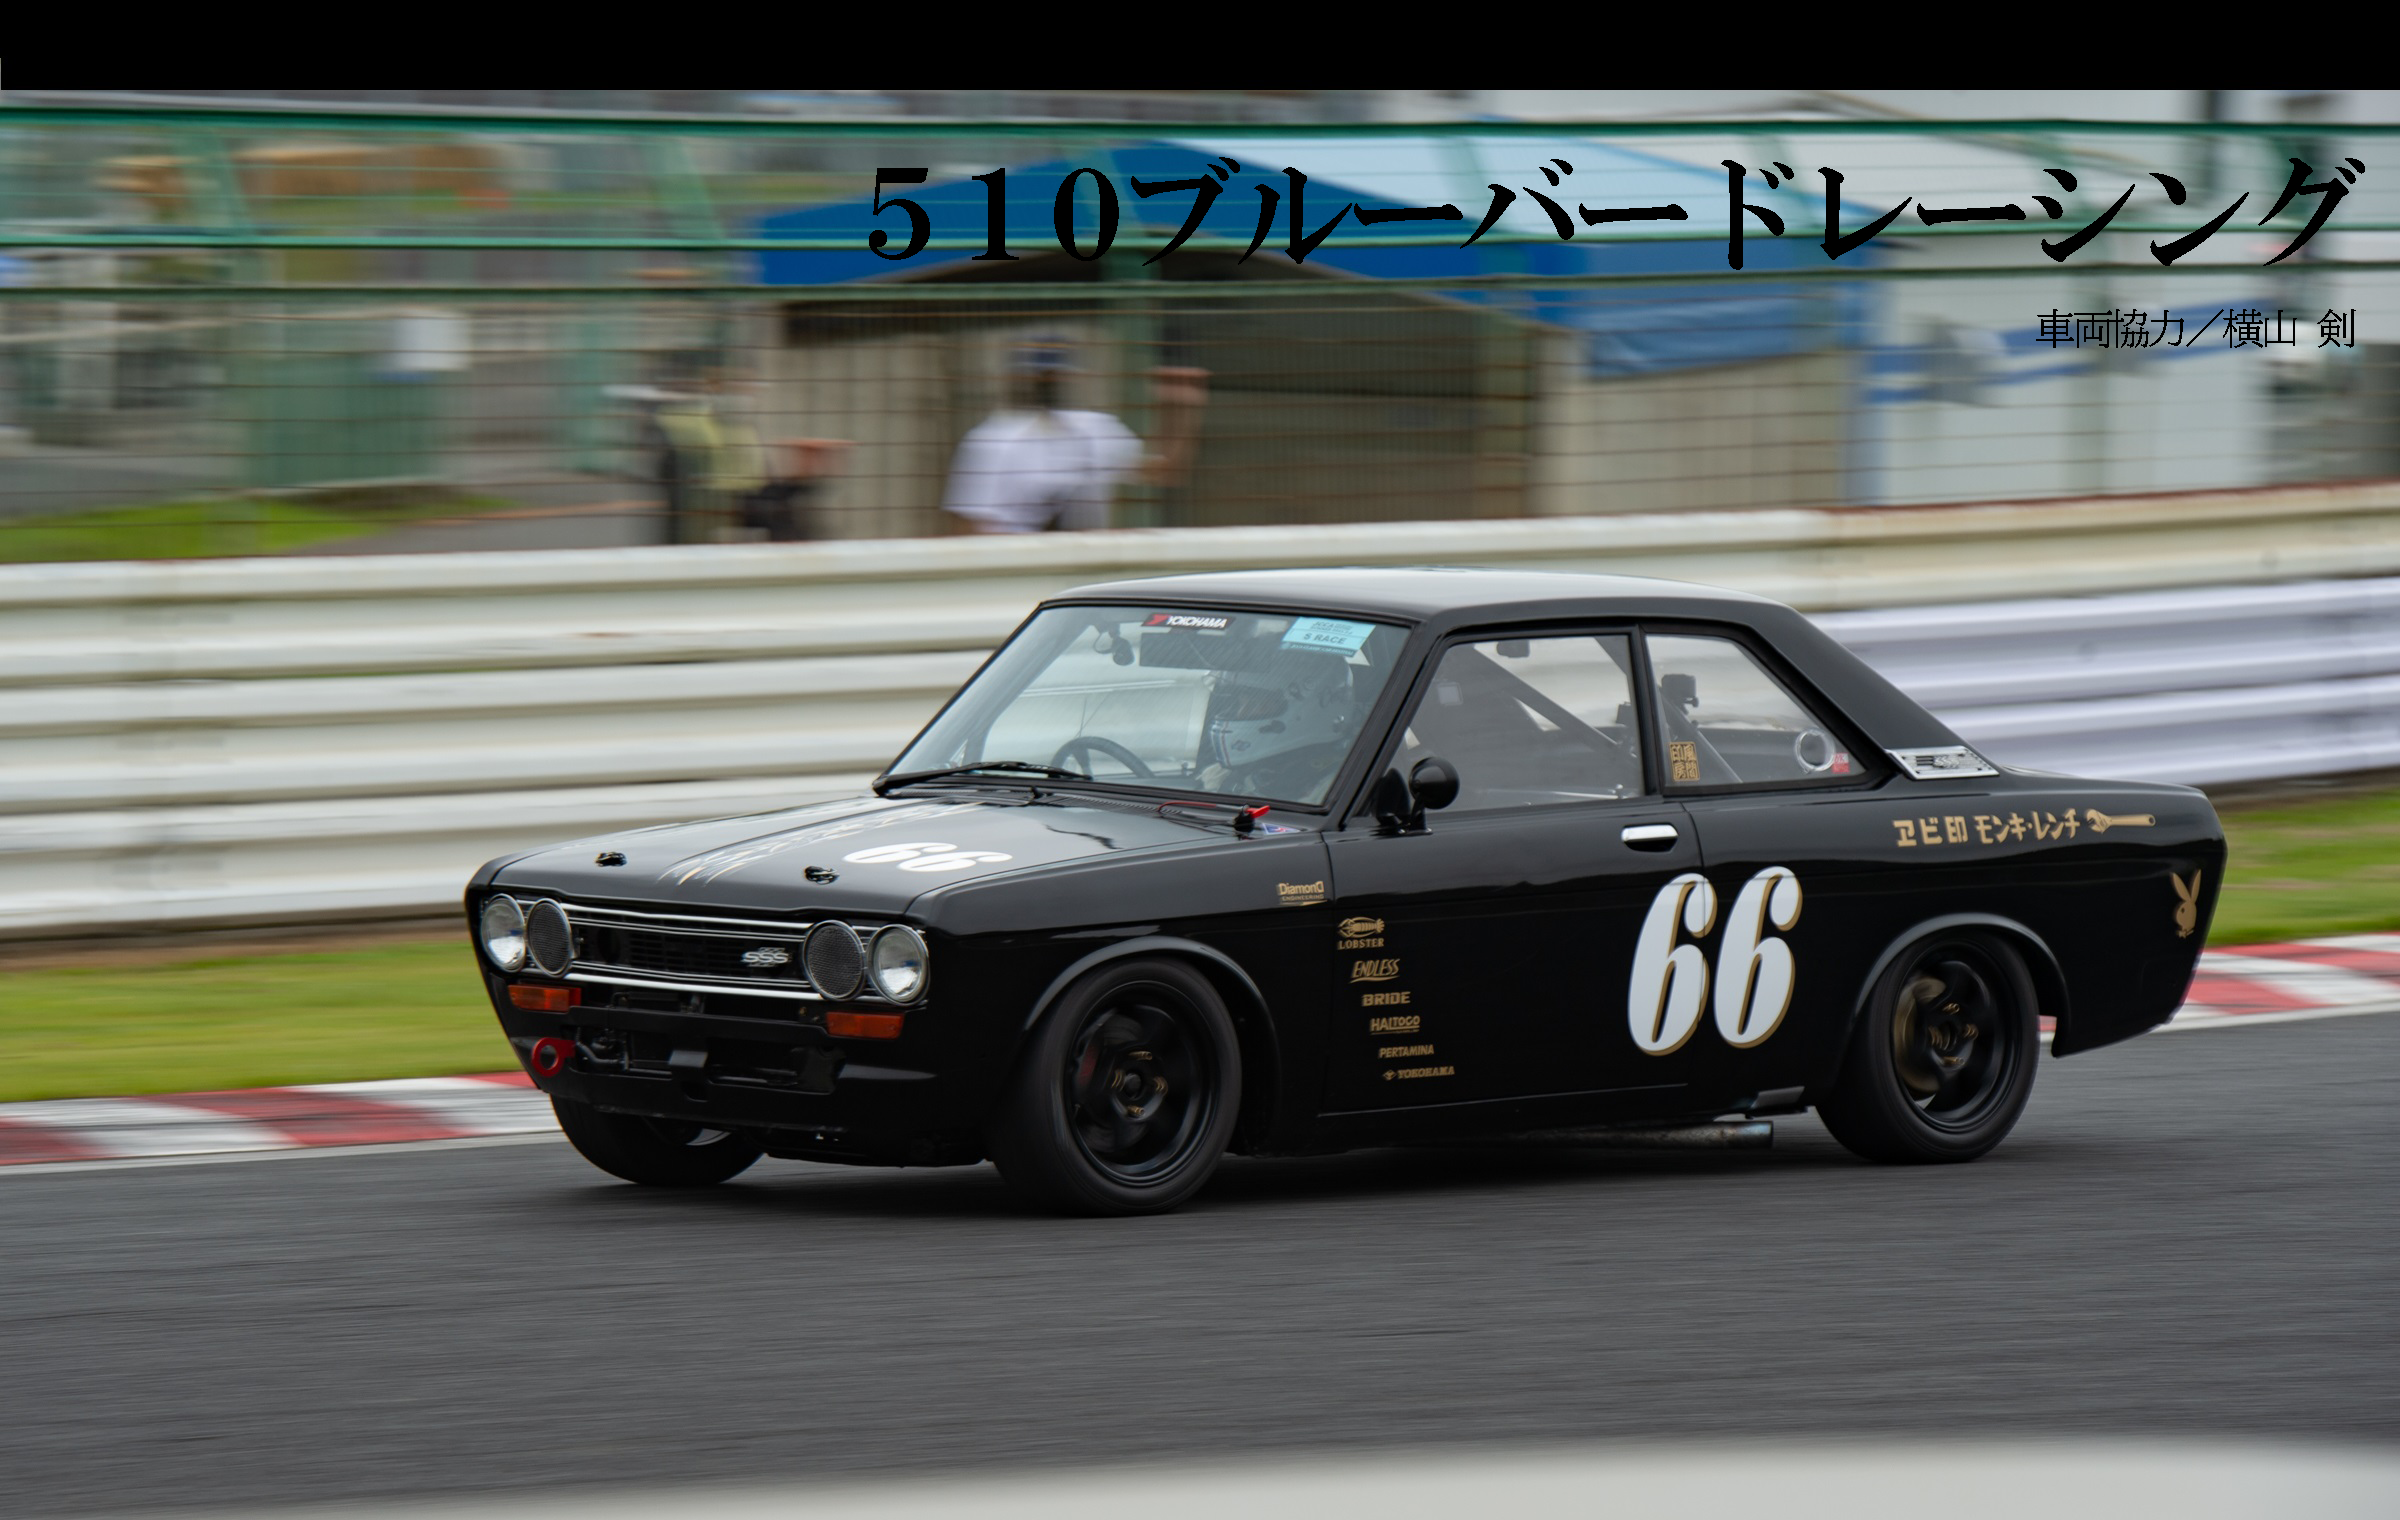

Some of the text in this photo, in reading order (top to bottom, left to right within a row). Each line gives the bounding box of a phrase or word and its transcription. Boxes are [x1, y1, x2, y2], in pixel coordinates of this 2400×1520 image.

[1166, 615, 1228, 628] YOKOHAMA
[1304, 632, 1347, 645] S RACE
[843, 842, 1013, 873] 66
[1338, 937, 1385, 950] LOBSTER
[742, 951, 789, 964] SSS
[1627, 865, 1804, 1057] 66
[1352, 958, 1401, 979] ENDLESS
[1362, 991, 1411, 1007] BRIDE
[1379, 1044, 1435, 1058] PERTAMINA
[1397, 1066, 1455, 1079] YOKOHAMA
